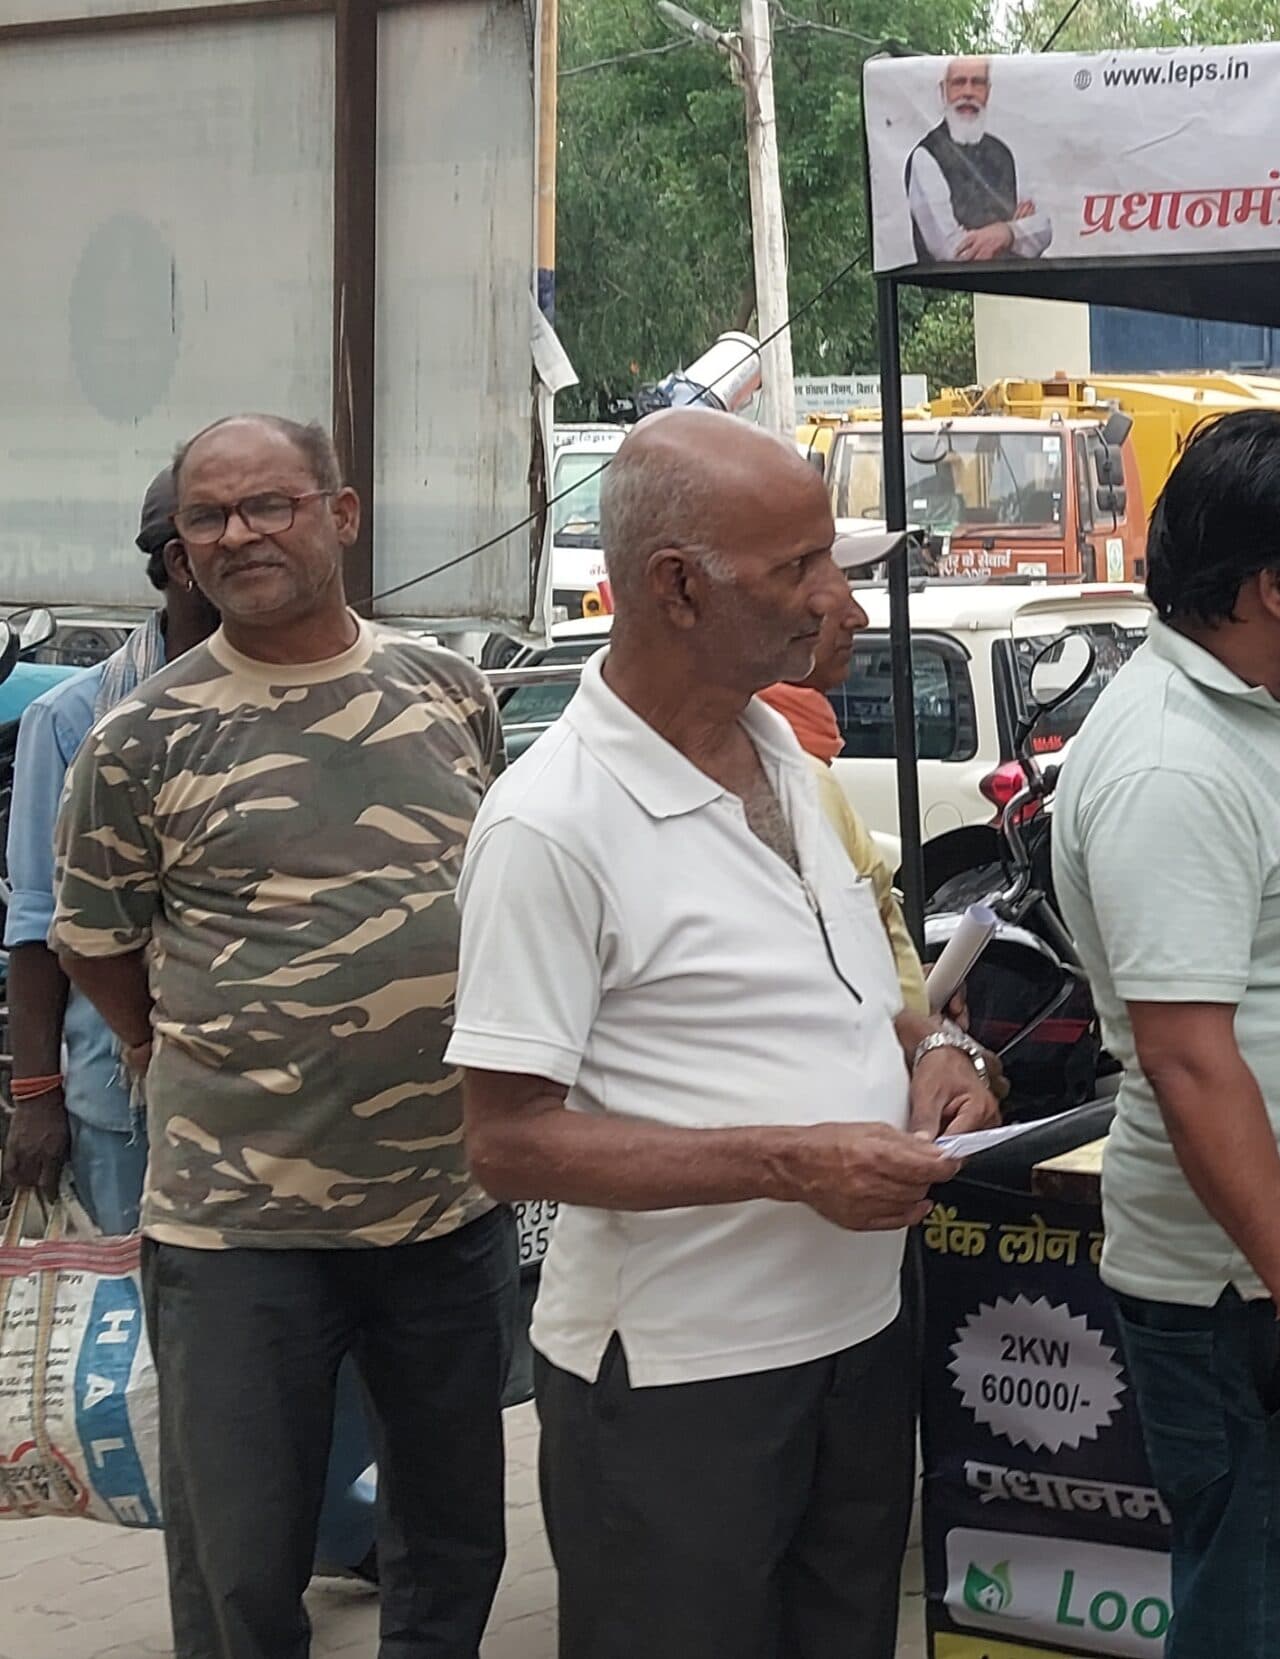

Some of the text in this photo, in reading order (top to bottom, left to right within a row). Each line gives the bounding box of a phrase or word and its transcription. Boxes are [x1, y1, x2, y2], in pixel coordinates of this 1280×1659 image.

[1103, 56, 1250, 88] www.leps.in
[923, 1202, 992, 1257] बैंक
[998, 1212, 1081, 1266] लोन
[1000, 1332, 1070, 1369] 2KW
[981, 1373, 1092, 1415] 60000/-
